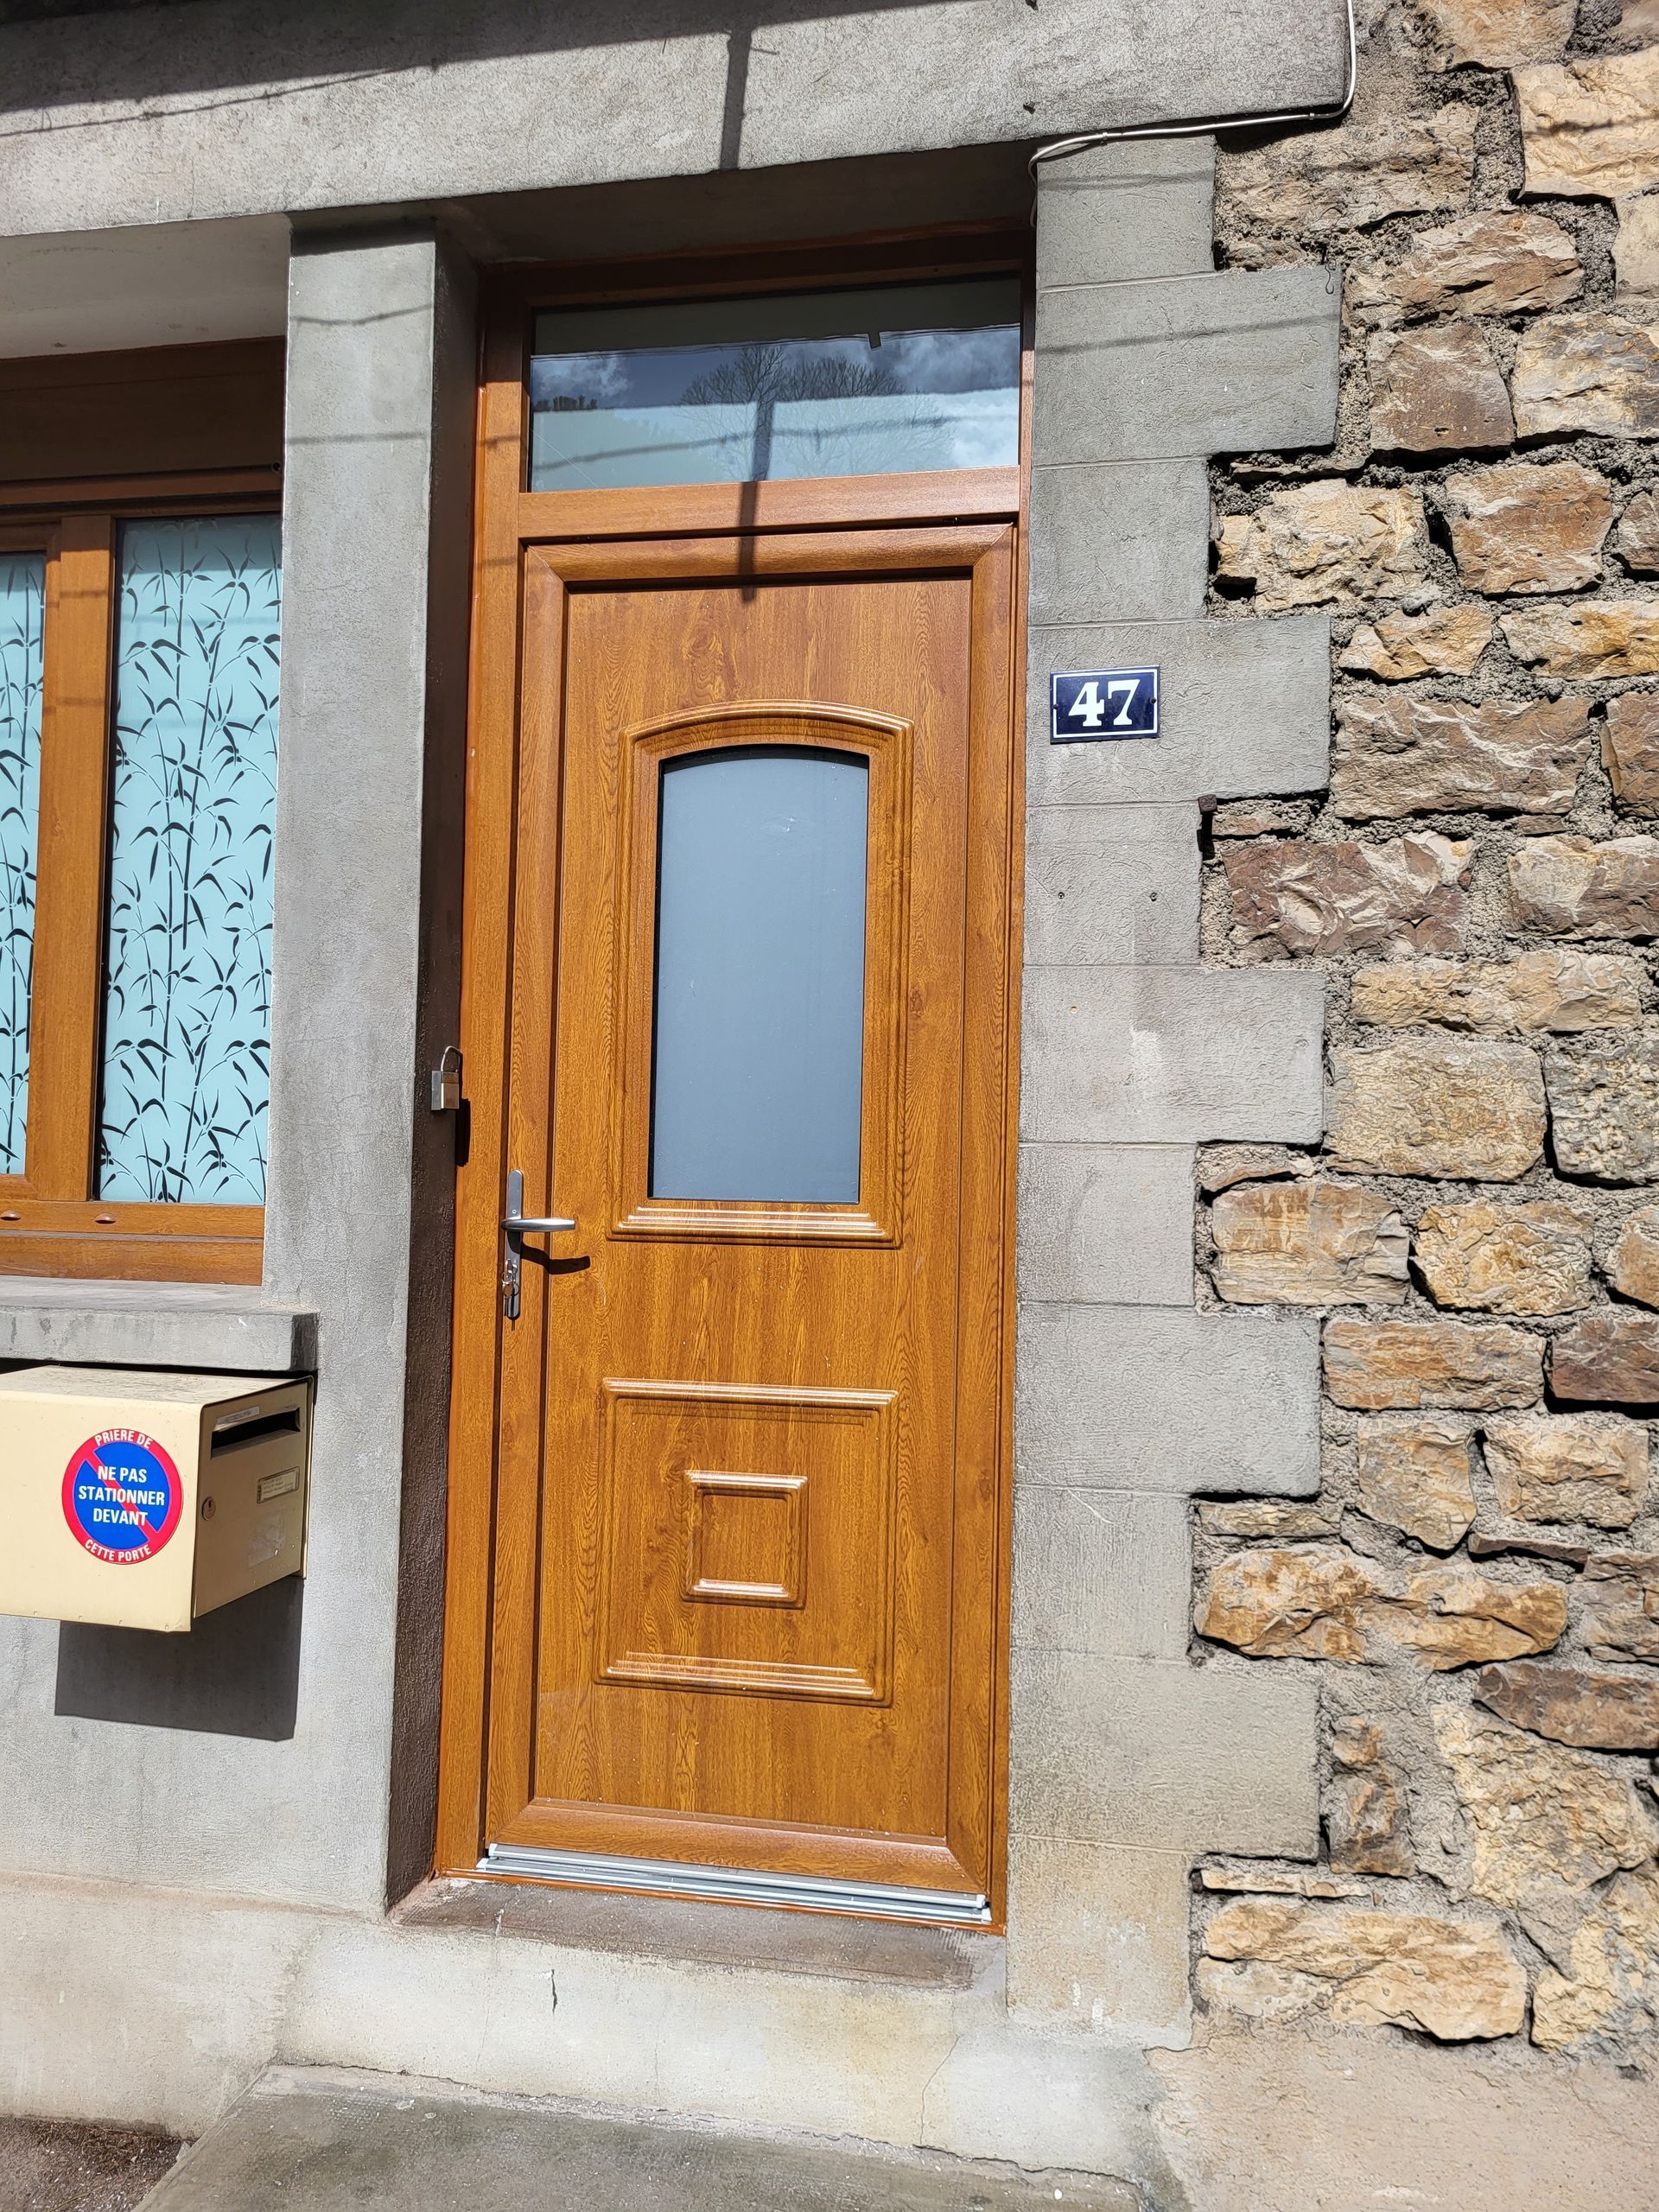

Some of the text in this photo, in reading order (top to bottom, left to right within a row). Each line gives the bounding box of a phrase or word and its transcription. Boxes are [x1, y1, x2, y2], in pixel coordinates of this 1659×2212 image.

[1068, 679, 1141, 727] 47
[94, 1429, 153, 1449] PRIERE DE
[98, 1465, 147, 1483] NE PAS
[78, 1485, 165, 1506] STATIONNER
[92, 1508, 148, 1526] DEVANT
[85, 1538, 152, 1562] CETTE PORTE
